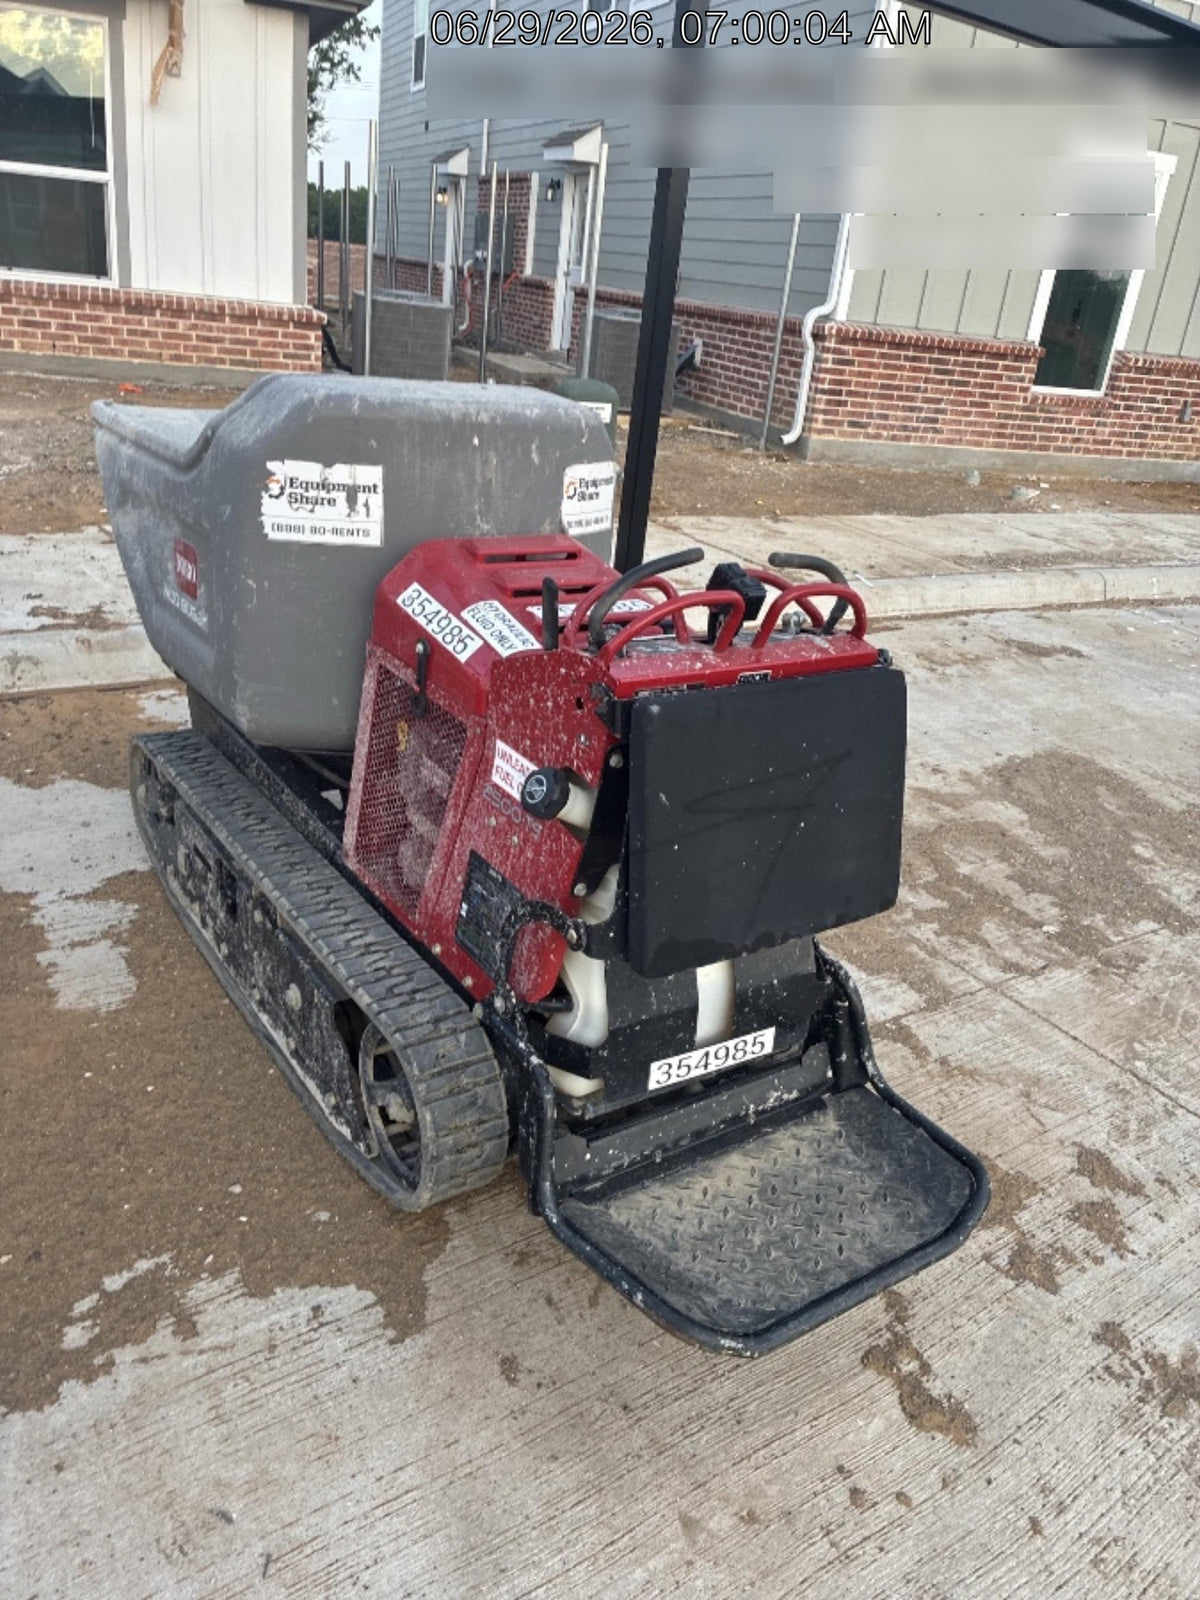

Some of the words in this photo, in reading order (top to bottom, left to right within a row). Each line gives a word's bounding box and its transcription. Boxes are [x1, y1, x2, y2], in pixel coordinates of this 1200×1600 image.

[288, 492, 337, 507] Share
[401, 588, 475, 655] 354985
[656, 1034, 765, 1085] 354985
